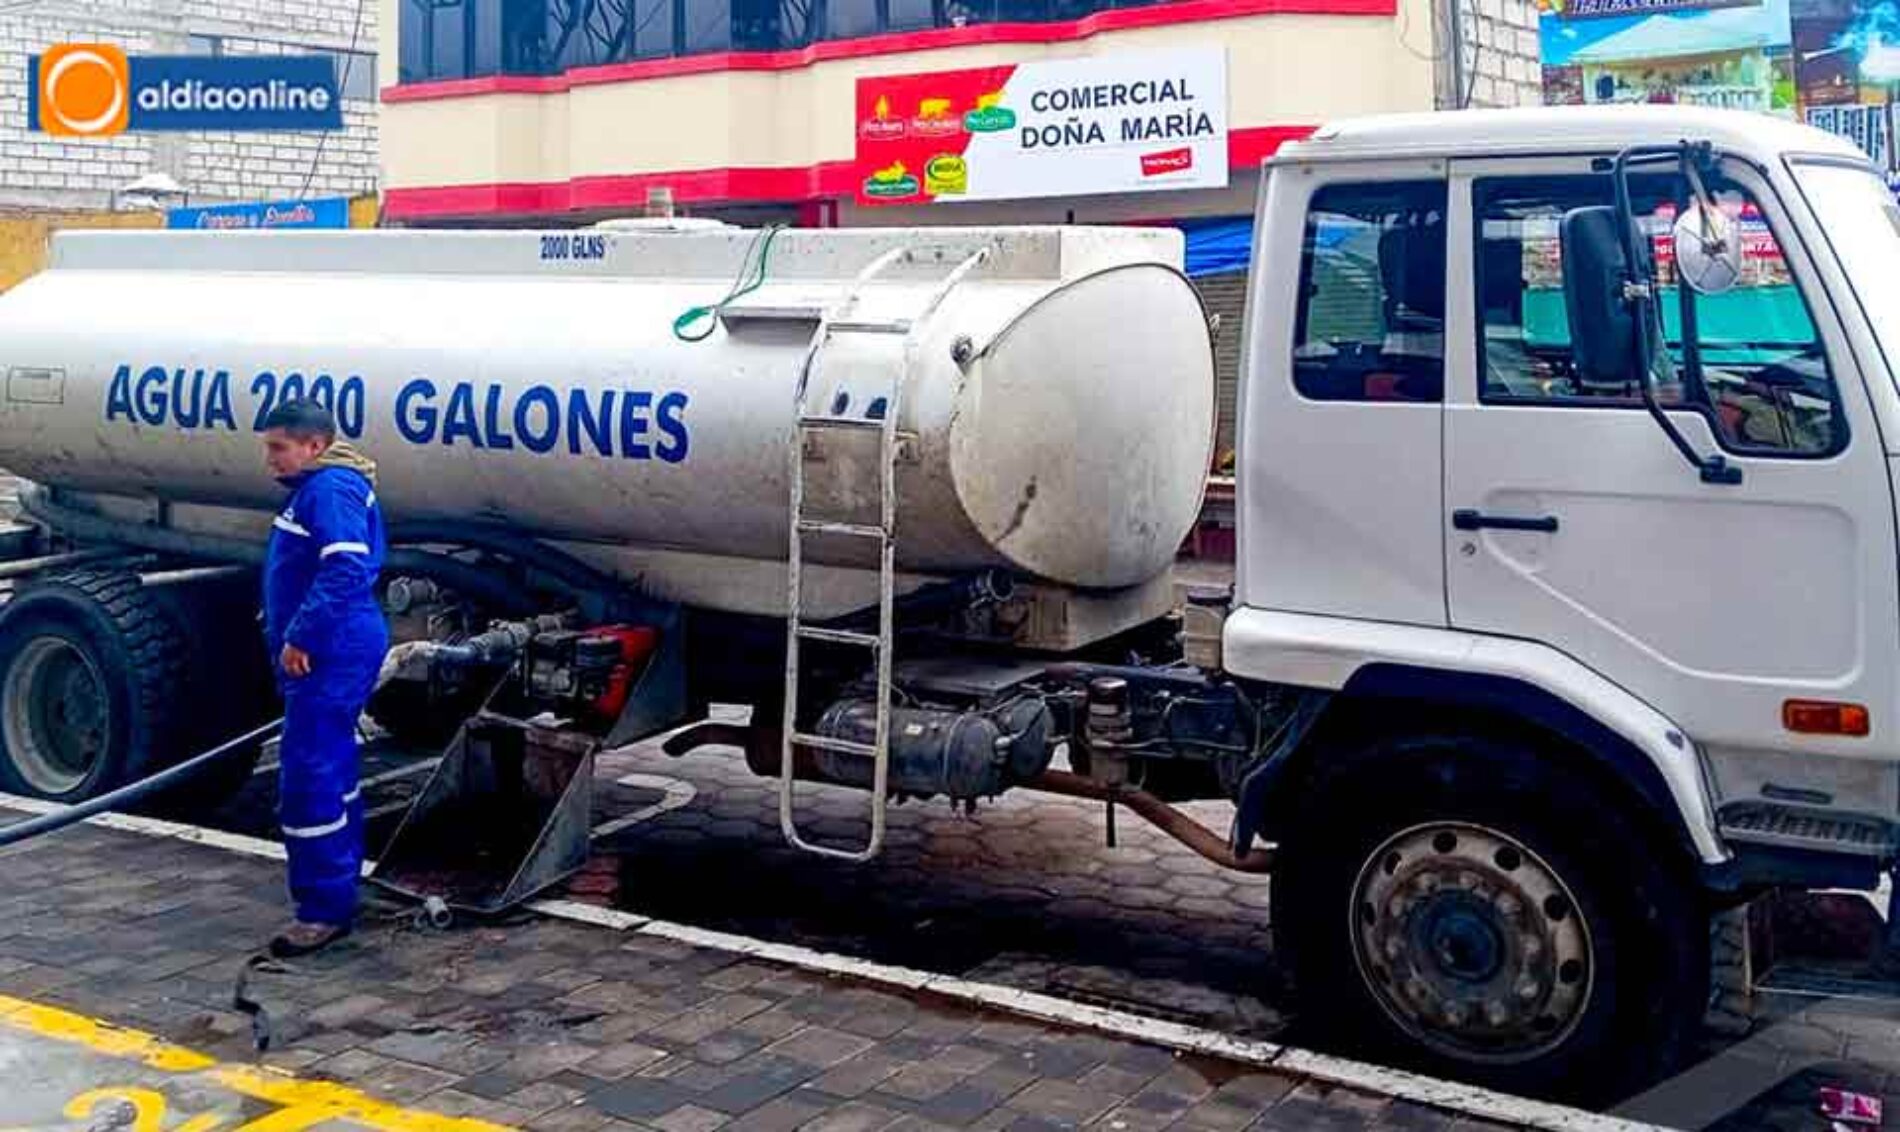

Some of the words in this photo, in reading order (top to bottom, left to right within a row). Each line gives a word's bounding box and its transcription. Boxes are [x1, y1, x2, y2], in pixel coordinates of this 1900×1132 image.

[1031, 78, 1195, 112] COMERCIAL
[1020, 117, 1105, 149] DOÑA
[1121, 107, 1215, 141] MARÍA
[540, 234, 570, 260] 2000
[571, 234, 605, 260] GLNS
[106, 363, 238, 431] AGUA
[393, 378, 691, 462] GALONES
